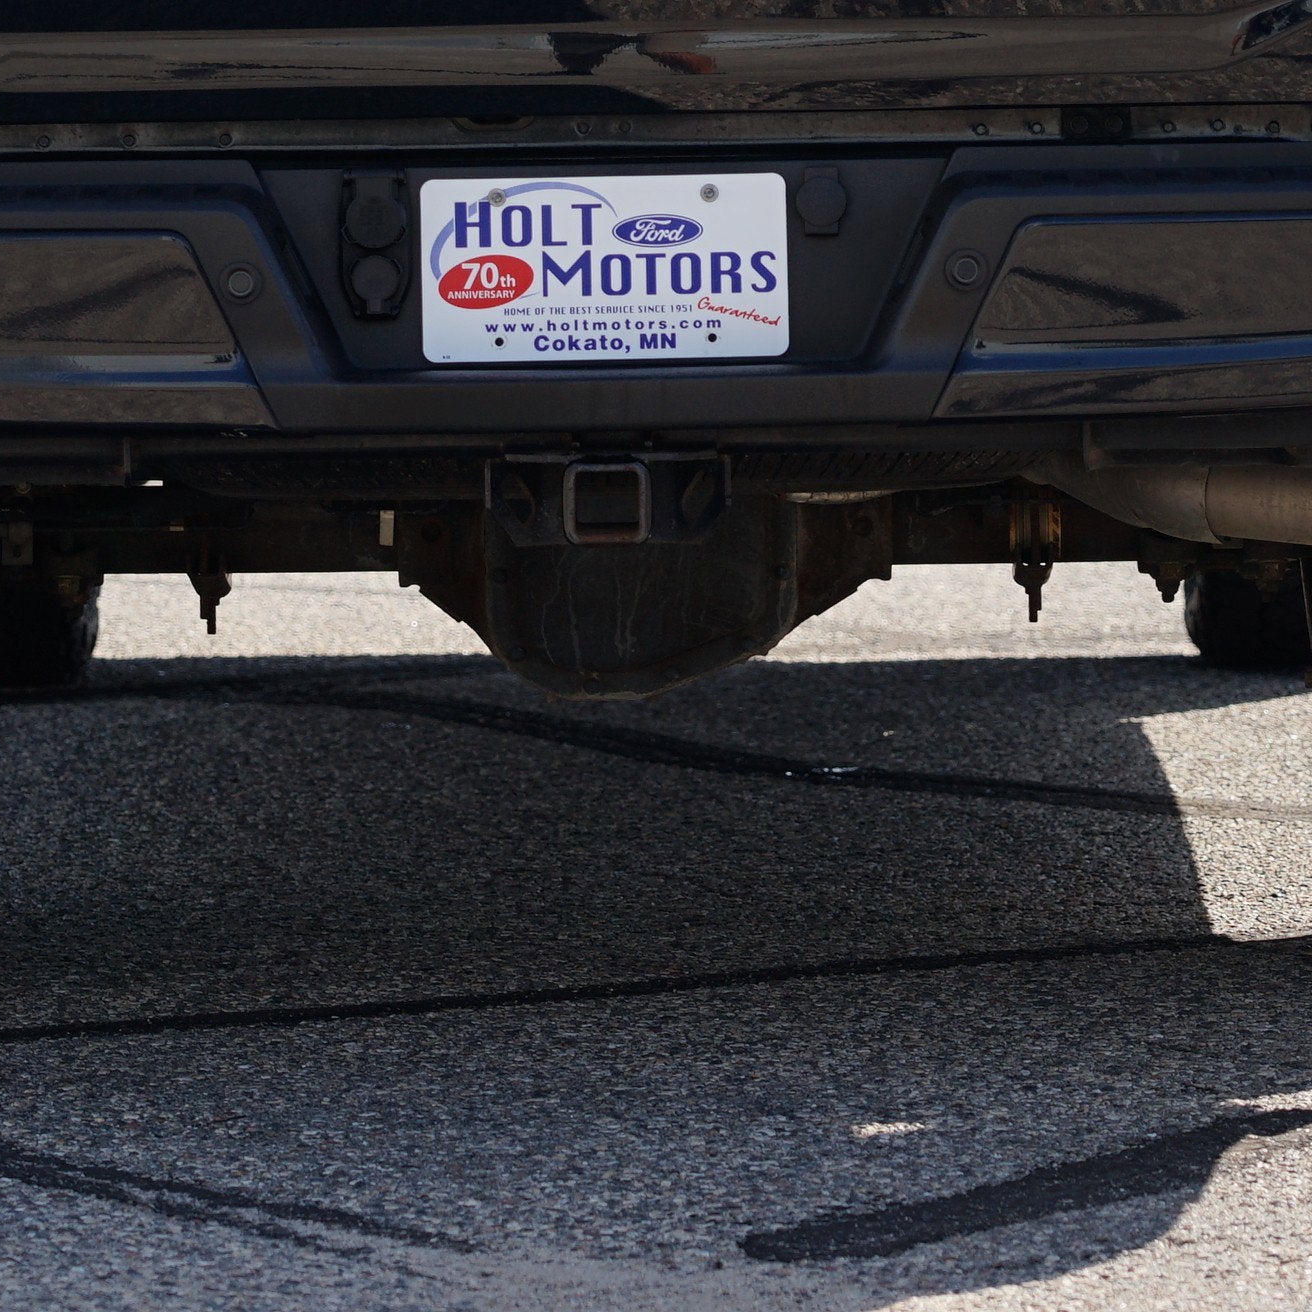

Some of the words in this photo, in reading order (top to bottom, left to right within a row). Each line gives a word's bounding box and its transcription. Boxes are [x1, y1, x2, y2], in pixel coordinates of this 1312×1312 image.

[454, 201, 602, 248] HOLT
[630, 219, 685, 242] Ford
[461, 262, 516, 290] 70th
[542, 250, 777, 298] MOTORS
[447, 289, 515, 300] ANNIVERSARY
[504, 308, 531, 316] HOME
[534, 307, 546, 316] OF
[550, 307, 566, 315] THE
[569, 306, 592, 315] BEST
[595, 305, 634, 314] SERVICE
[638, 305, 666, 314] SINCE
[670, 304, 693, 313] 1951
[697, 297, 781, 326] Guaranteed
[485, 318, 722, 332] www.holtmotors.com
[533, 334, 631, 352] Cokato,
[639, 333, 677, 349] MN
